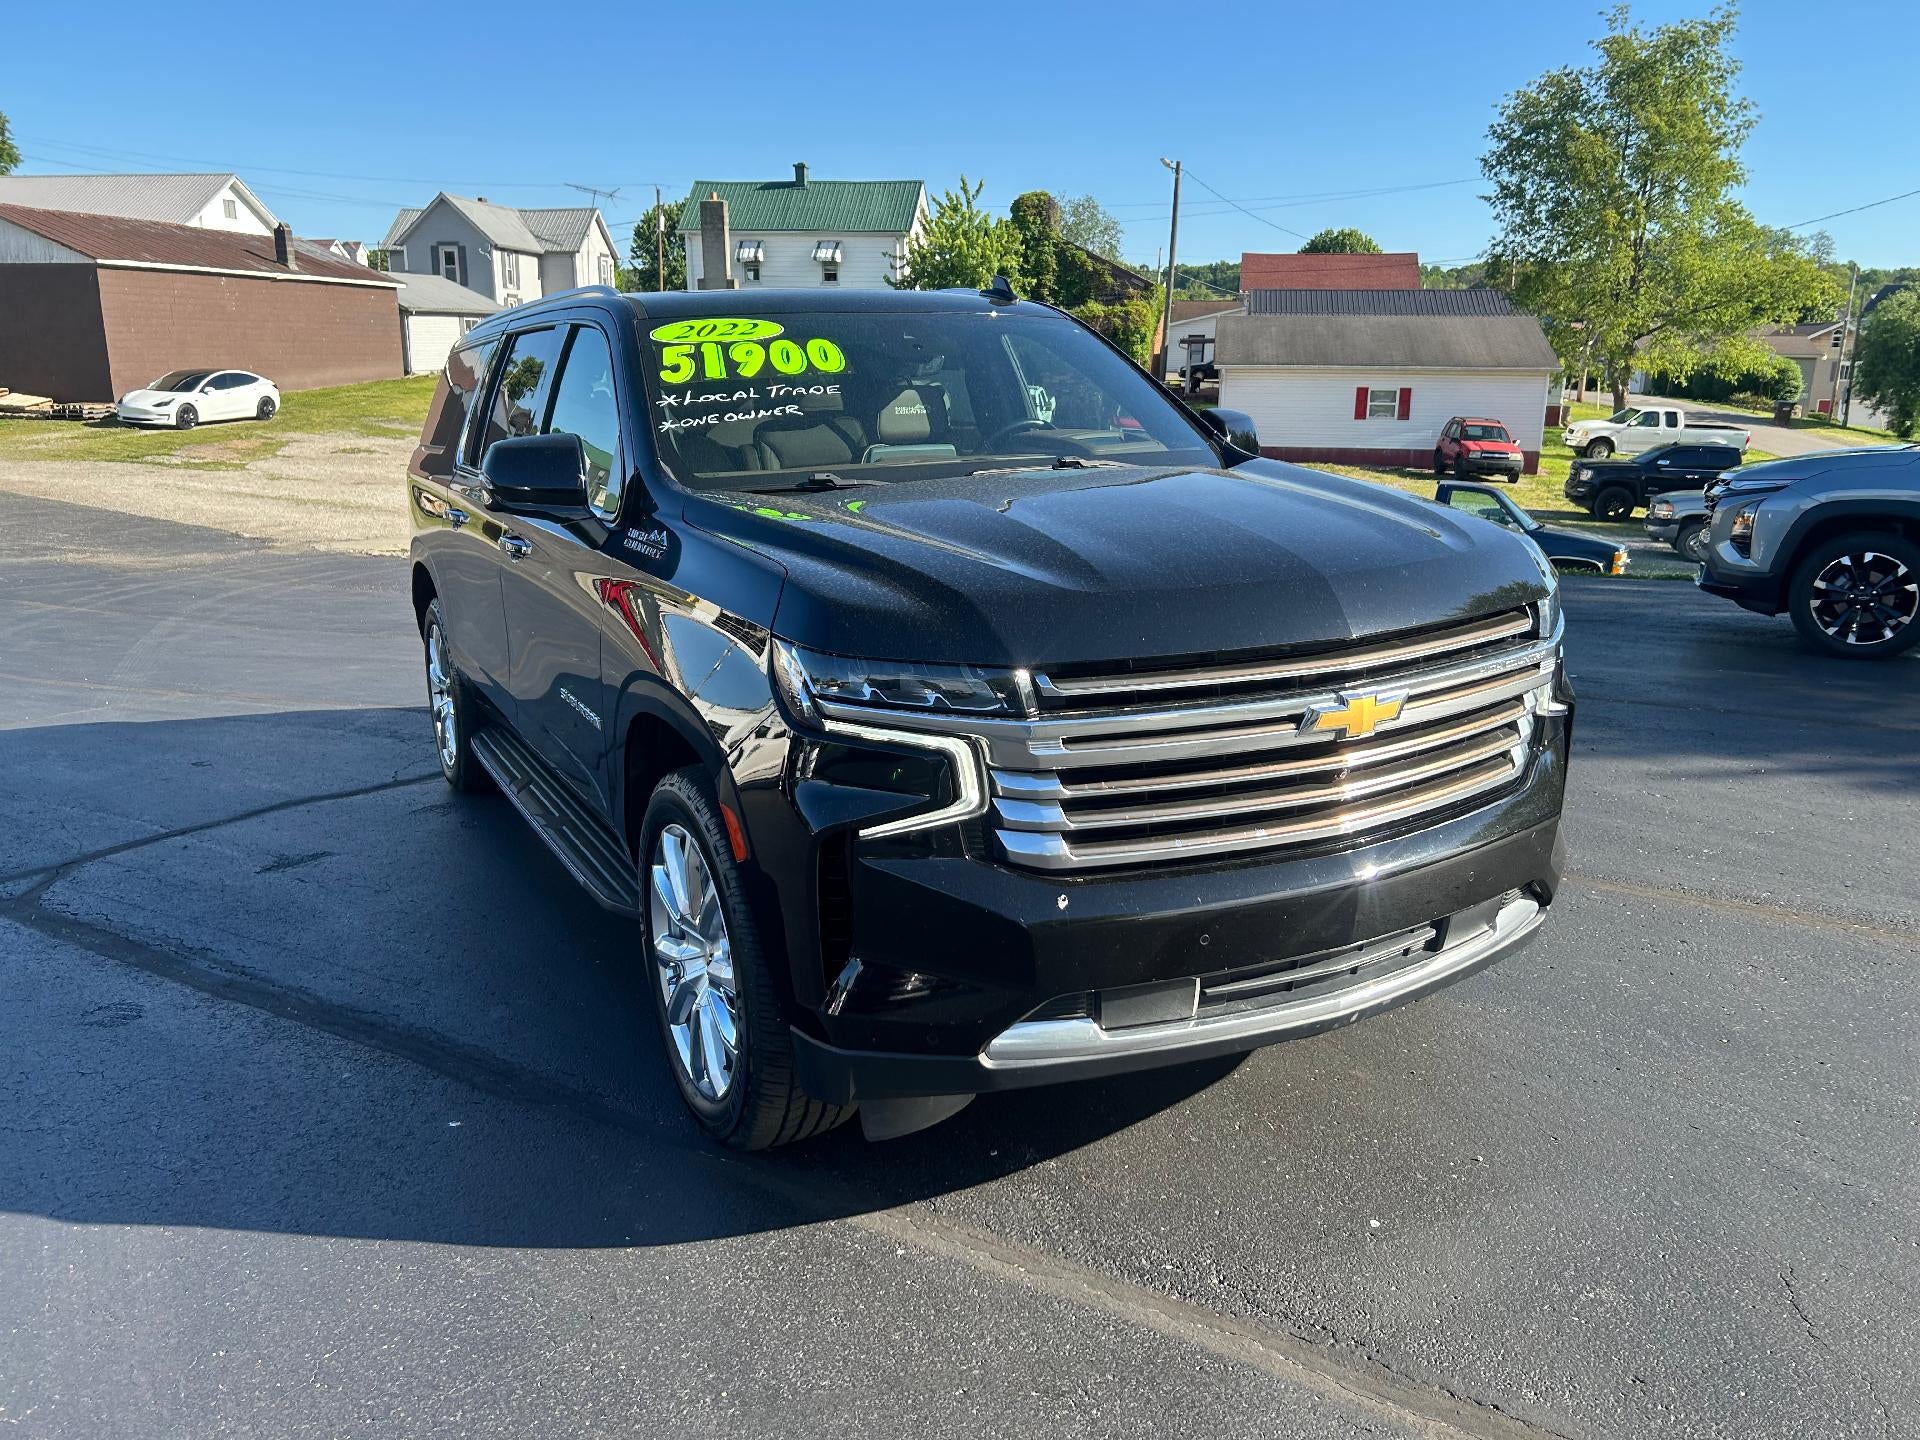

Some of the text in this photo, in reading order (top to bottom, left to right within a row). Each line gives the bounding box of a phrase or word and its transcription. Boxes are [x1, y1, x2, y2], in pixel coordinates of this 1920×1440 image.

[673, 322, 760, 339] 2022
[659, 338, 846, 383] 51900
[724, 405, 804, 422] OWNER
